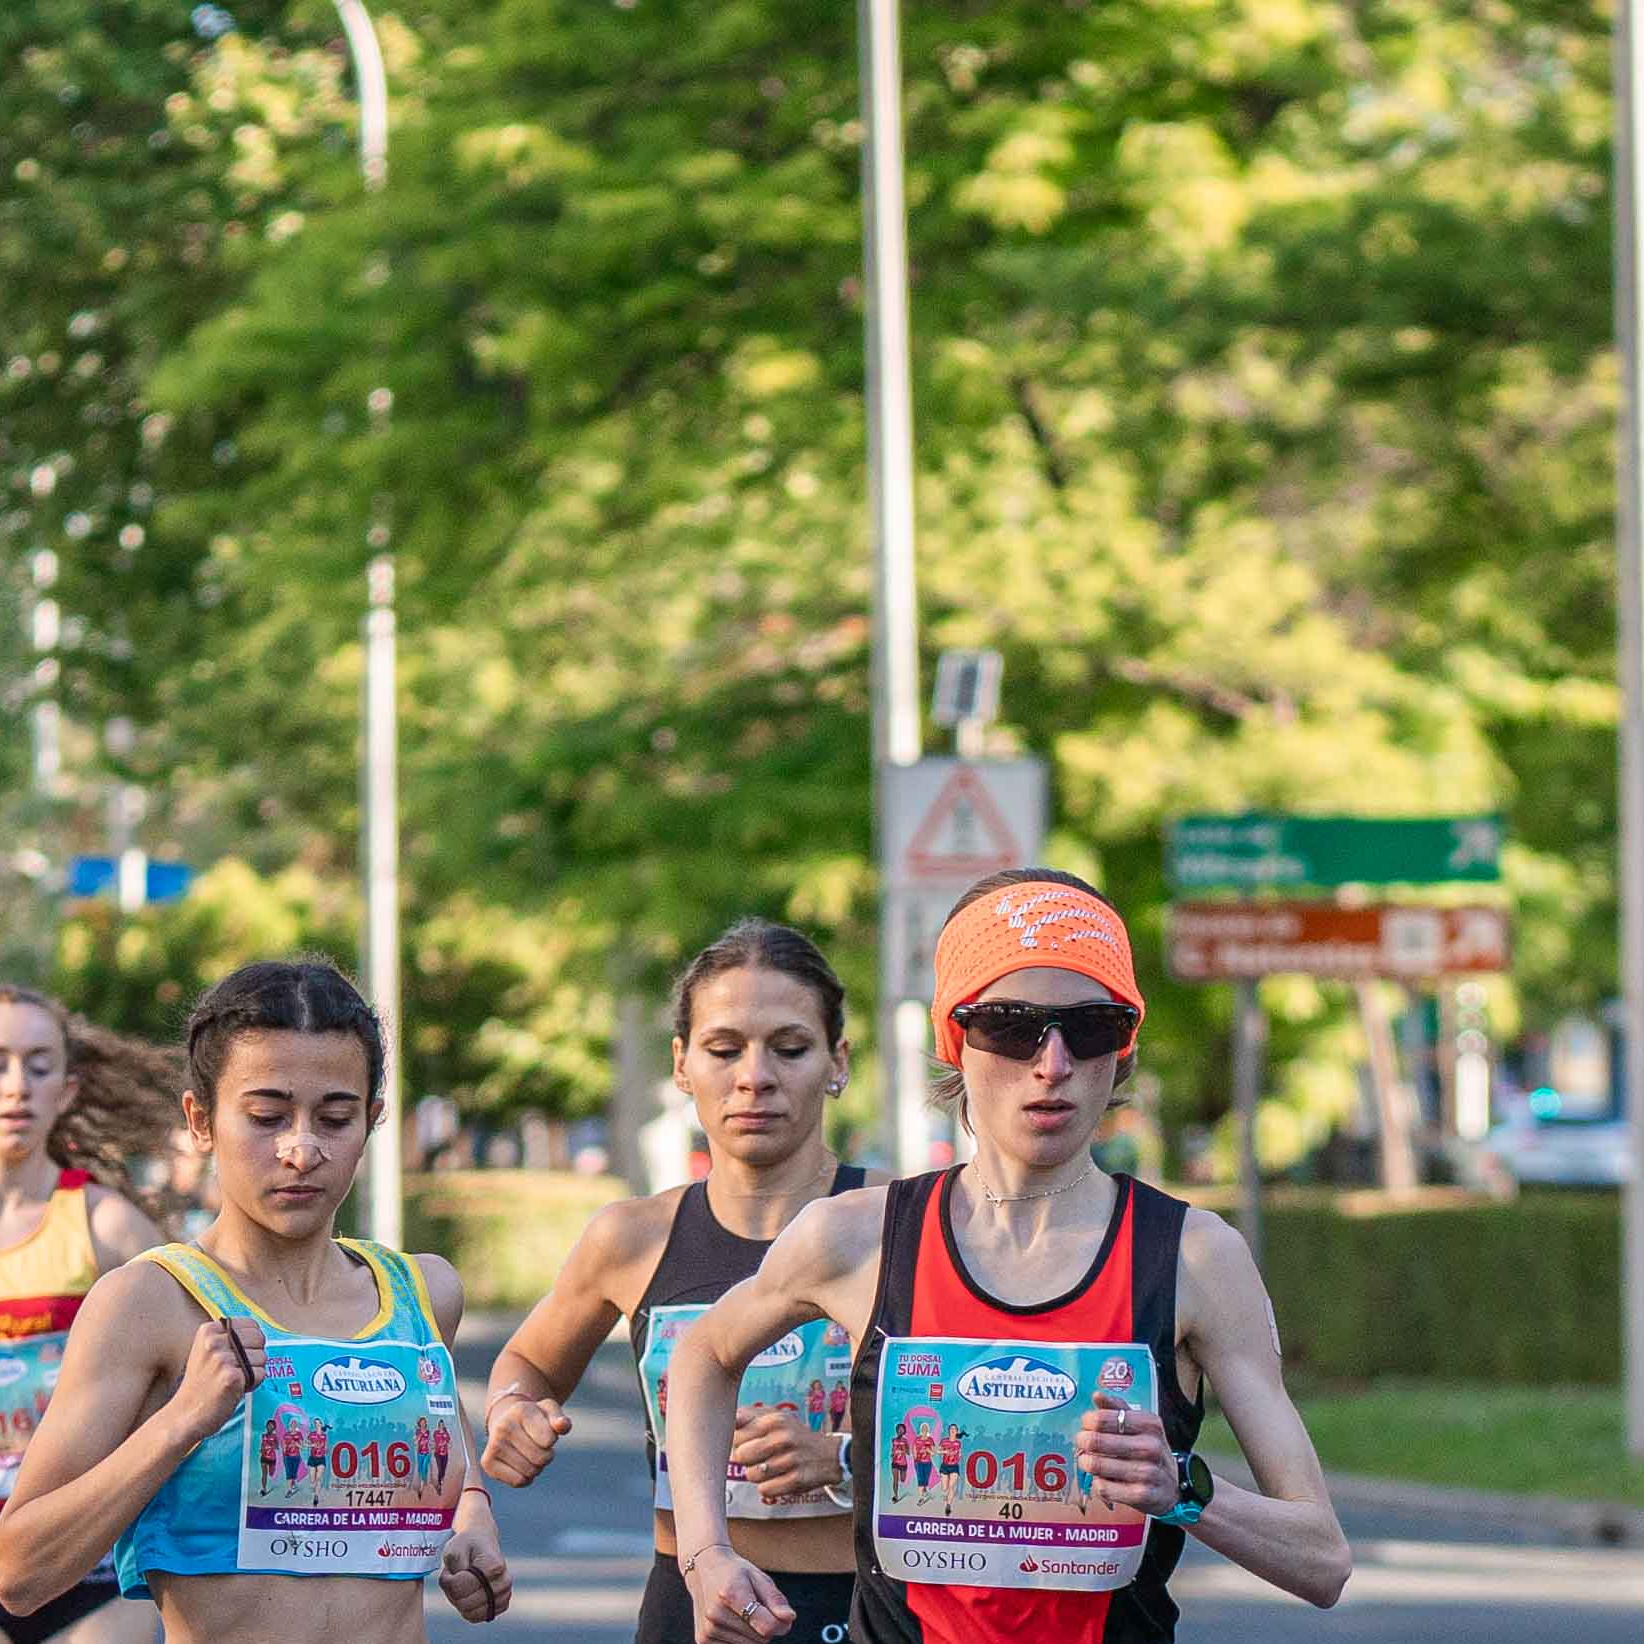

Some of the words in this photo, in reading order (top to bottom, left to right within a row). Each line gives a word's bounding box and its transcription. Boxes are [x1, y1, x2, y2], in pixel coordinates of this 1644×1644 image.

[911, 1355, 942, 1363] DORSAL
[898, 1363, 940, 1376] SUMA
[1105, 1362, 1128, 1379] 20
[320, 1371, 402, 1393] ASTURIANA
[965, 1375, 1068, 1400] ASTURIANA
[331, 1441, 411, 1479] 016
[965, 1451, 1067, 1492] 016
[346, 1490, 394, 1506] 17447
[274, 1512, 329, 1525] CARRERA
[333, 1513, 349, 1525] DE
[352, 1513, 366, 1525] LA
[405, 1513, 443, 1526] MADRID
[999, 1503, 1023, 1519] 40
[906, 1521, 964, 1536] CARRERA
[969, 1525, 985, 1537] DE
[989, 1525, 1005, 1538] LA
[1009, 1526, 1053, 1540] MUJER
[1065, 1528, 1119, 1542] MADRID
[270, 1539, 349, 1558] OYSHO
[903, 1549, 987, 1571] OYSHO
[1041, 1559, 1120, 1575] Santander
